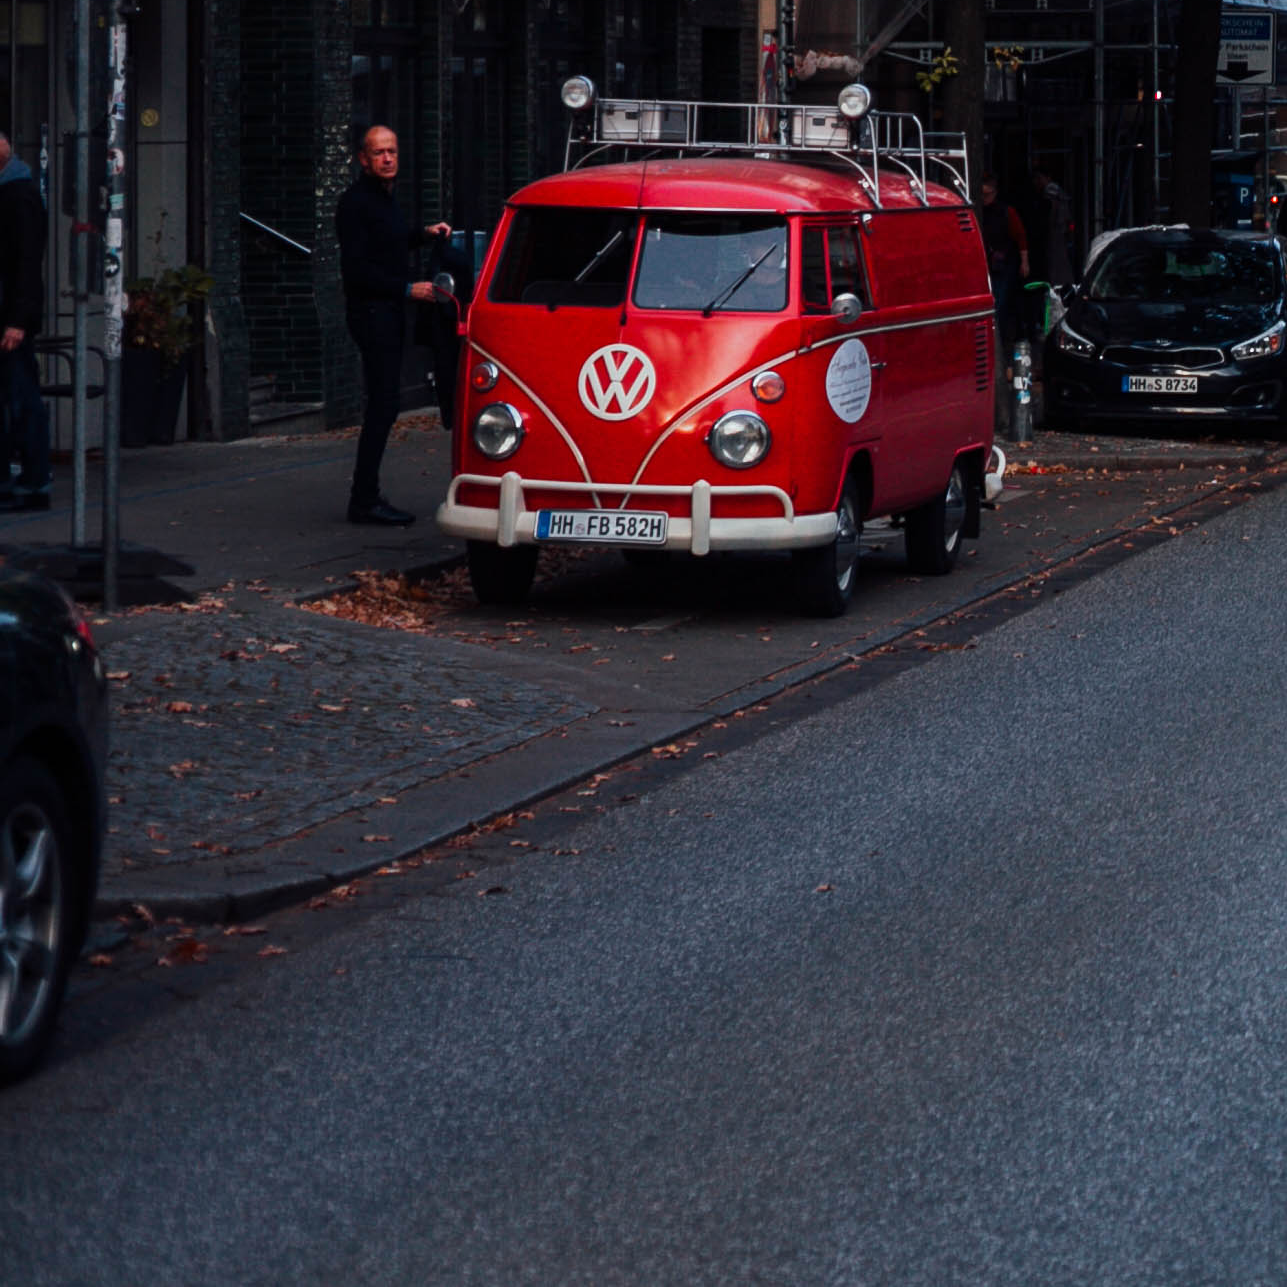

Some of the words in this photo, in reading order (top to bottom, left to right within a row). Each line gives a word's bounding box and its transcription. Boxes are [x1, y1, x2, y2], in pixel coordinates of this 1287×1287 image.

[1240, 186, 1249, 204] P
[1130, 378, 1146, 390] HH
[1154, 378, 1162, 391] S
[1165, 378, 1196, 391] 8734
[550, 515, 574, 534] HH
[586, 516, 610, 535] FB
[615, 516, 661, 538] 582H
